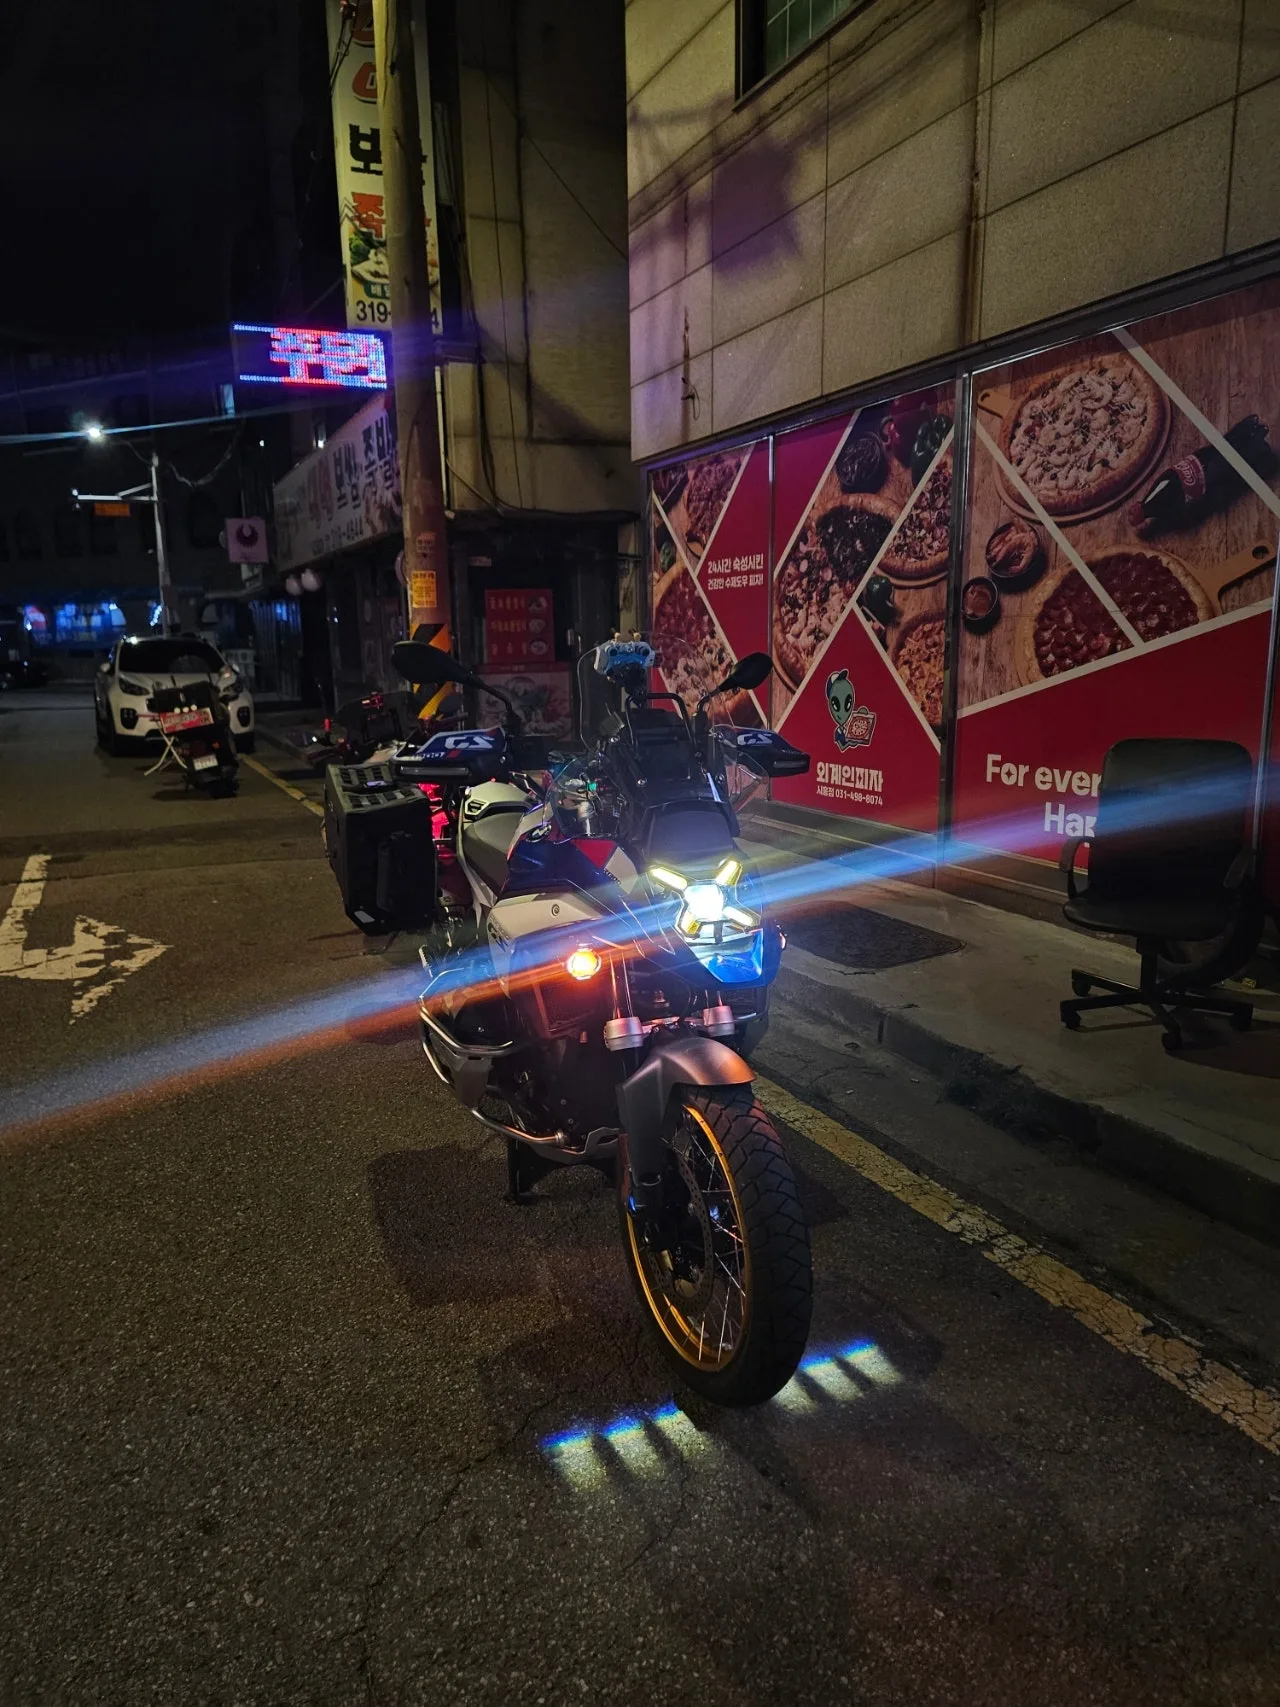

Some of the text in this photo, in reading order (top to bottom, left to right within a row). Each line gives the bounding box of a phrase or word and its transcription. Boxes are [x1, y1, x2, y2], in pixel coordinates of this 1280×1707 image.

[707, 553, 764, 574] 24시간 숙성시킨
[816, 761, 884, 793] 외계인피자
[985, 753, 1030, 788] For
